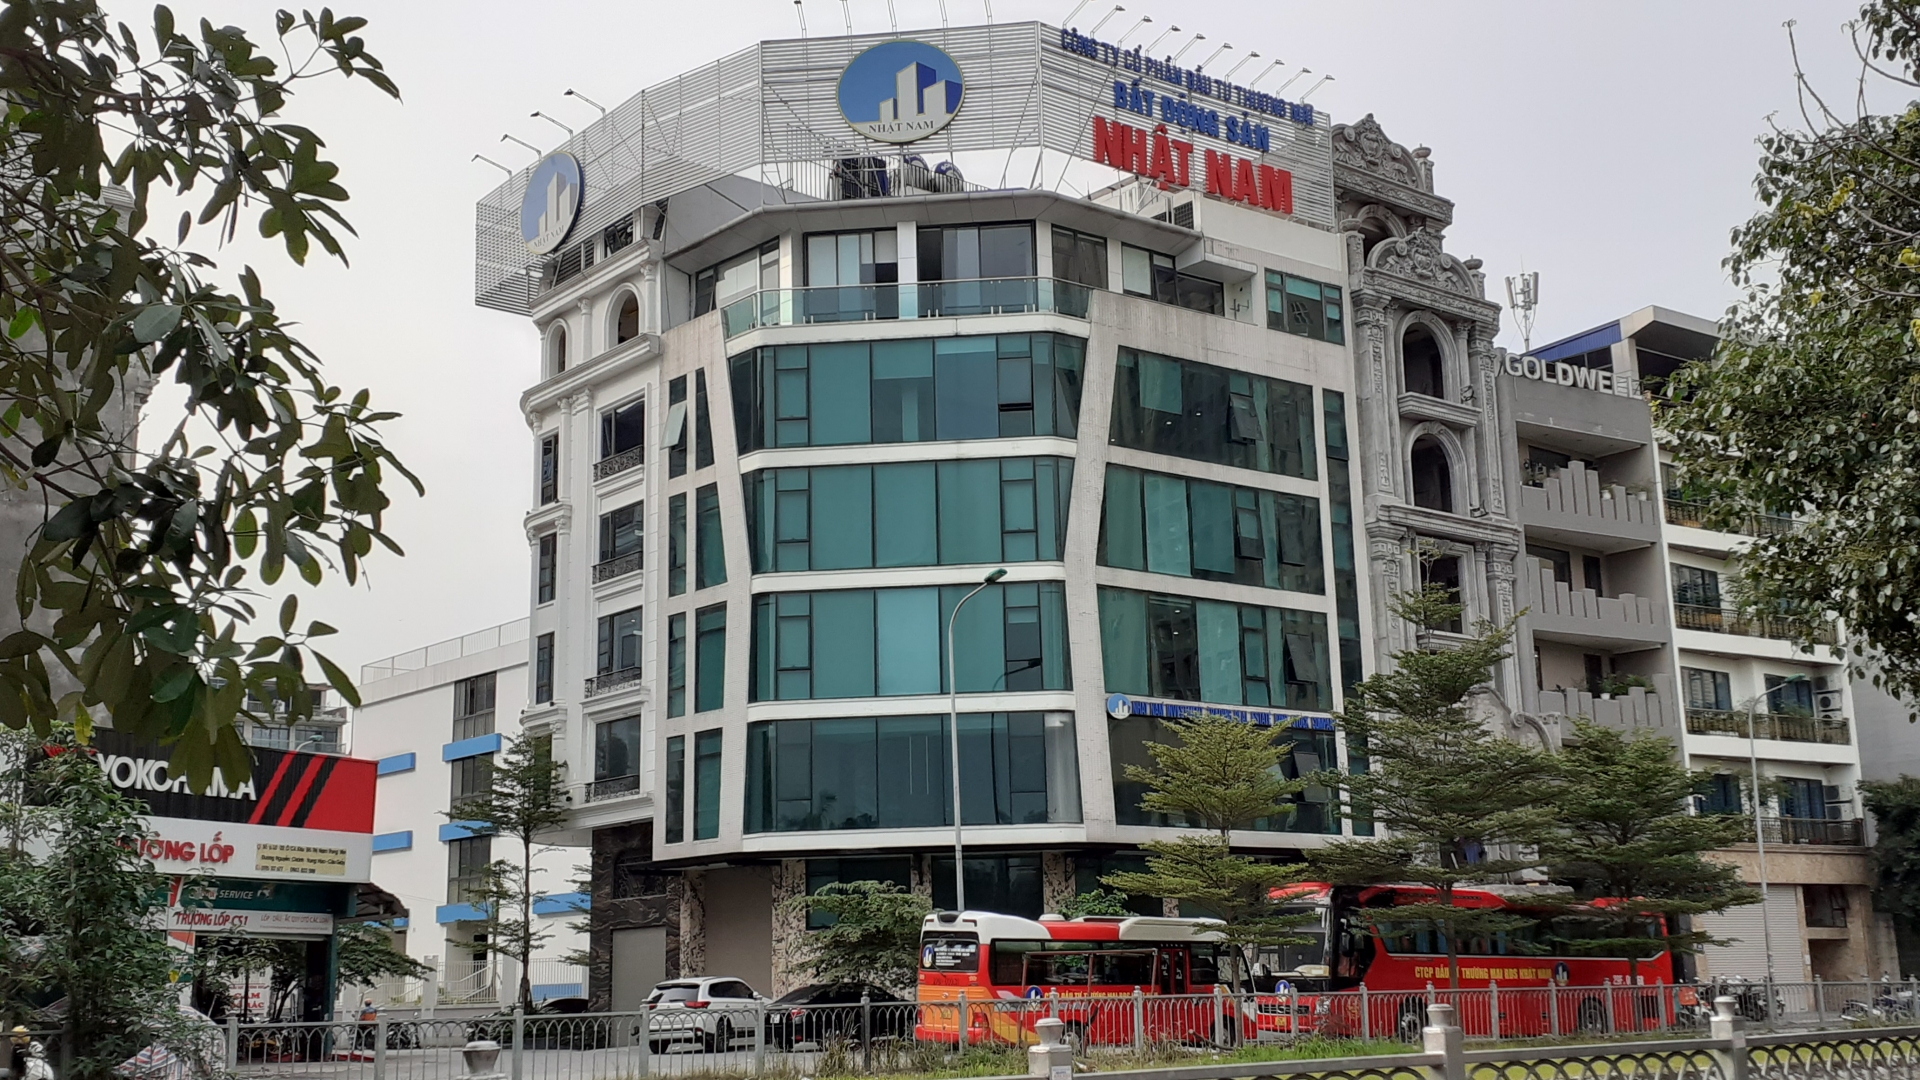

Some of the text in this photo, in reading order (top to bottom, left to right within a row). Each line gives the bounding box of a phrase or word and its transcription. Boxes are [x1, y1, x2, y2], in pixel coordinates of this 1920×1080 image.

[1061, 27, 1098, 59] CÔNG
[1101, 42, 1119, 66] TY
[906, 120, 934, 131] NAM
[1114, 76, 1270, 152] BẤT ĐỘNG SẢN
[1093, 116, 1294, 214] NHẬT NAM
[200, 831, 235, 864] LỐP
[219, 890, 254, 900] SERVICE
[213, 911, 231, 926] LỐP
[1415, 966, 1433, 978] CTCP
